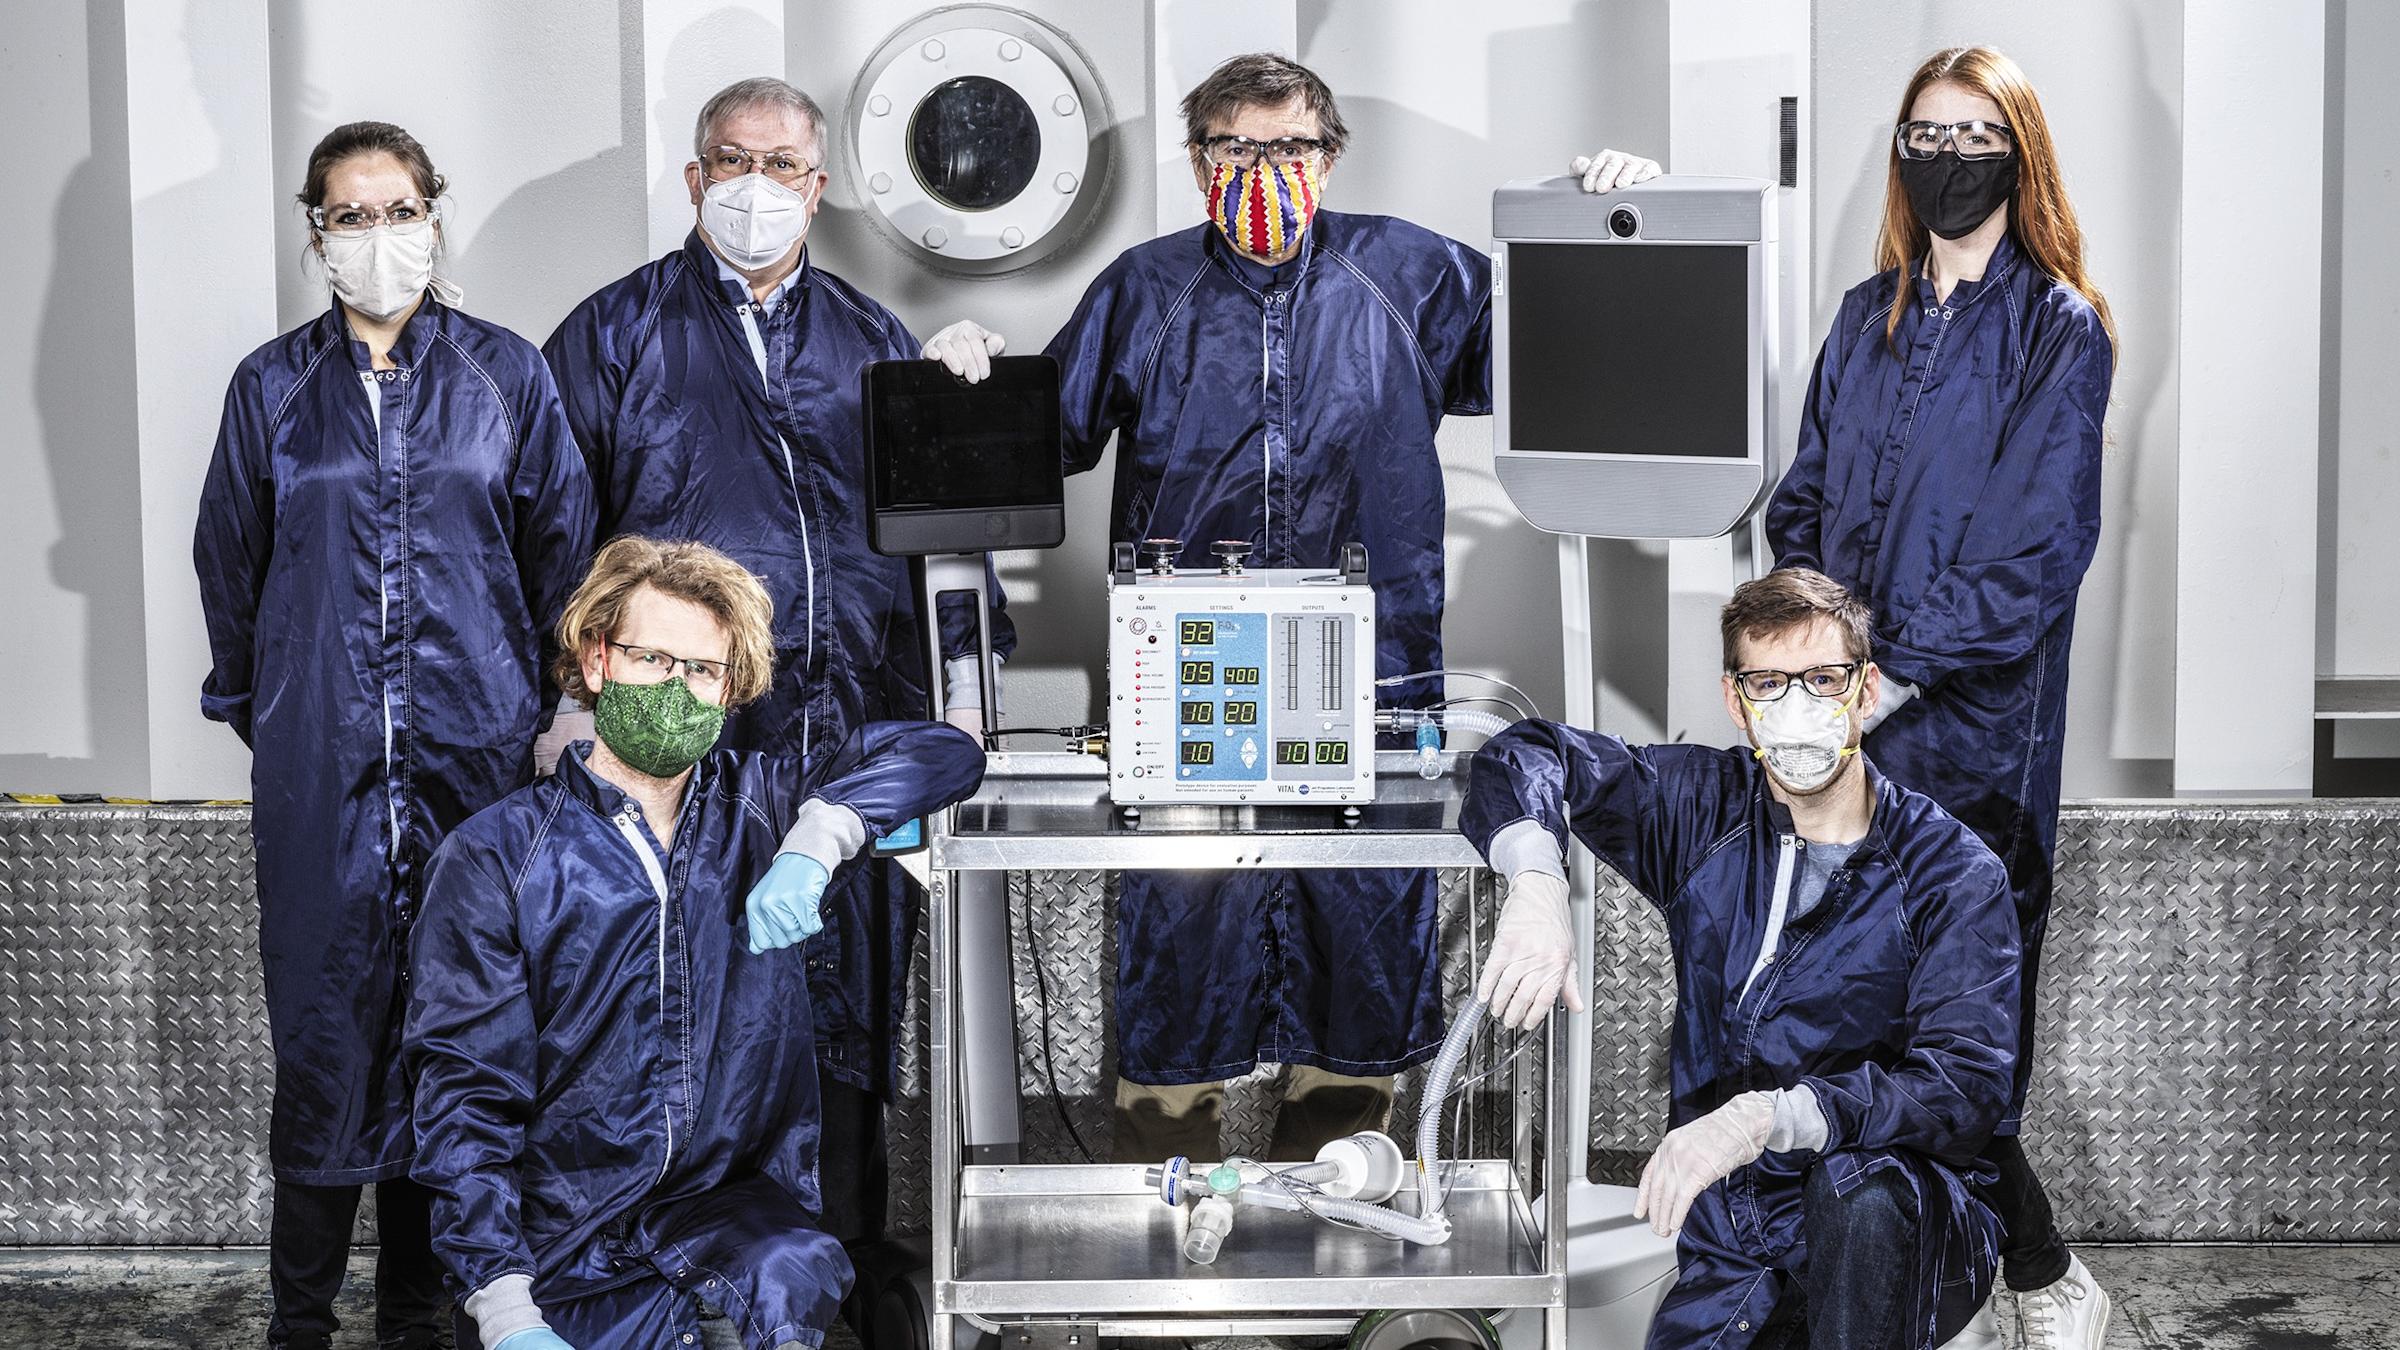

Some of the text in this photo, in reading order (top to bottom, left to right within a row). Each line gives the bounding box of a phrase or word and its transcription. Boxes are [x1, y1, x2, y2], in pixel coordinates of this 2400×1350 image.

[1183, 623, 1212, 642] 32
[1182, 663, 1212, 683] 05
[1226, 669, 1257, 682] 400
[1191, 703, 1212, 722] 10
[1225, 703, 1255, 722] 20
[1191, 743, 1212, 762] 1.0
[1286, 744, 1307, 762] 10
[1317, 744, 1346, 762] 00
[1277, 785, 1295, 793] VITAL
